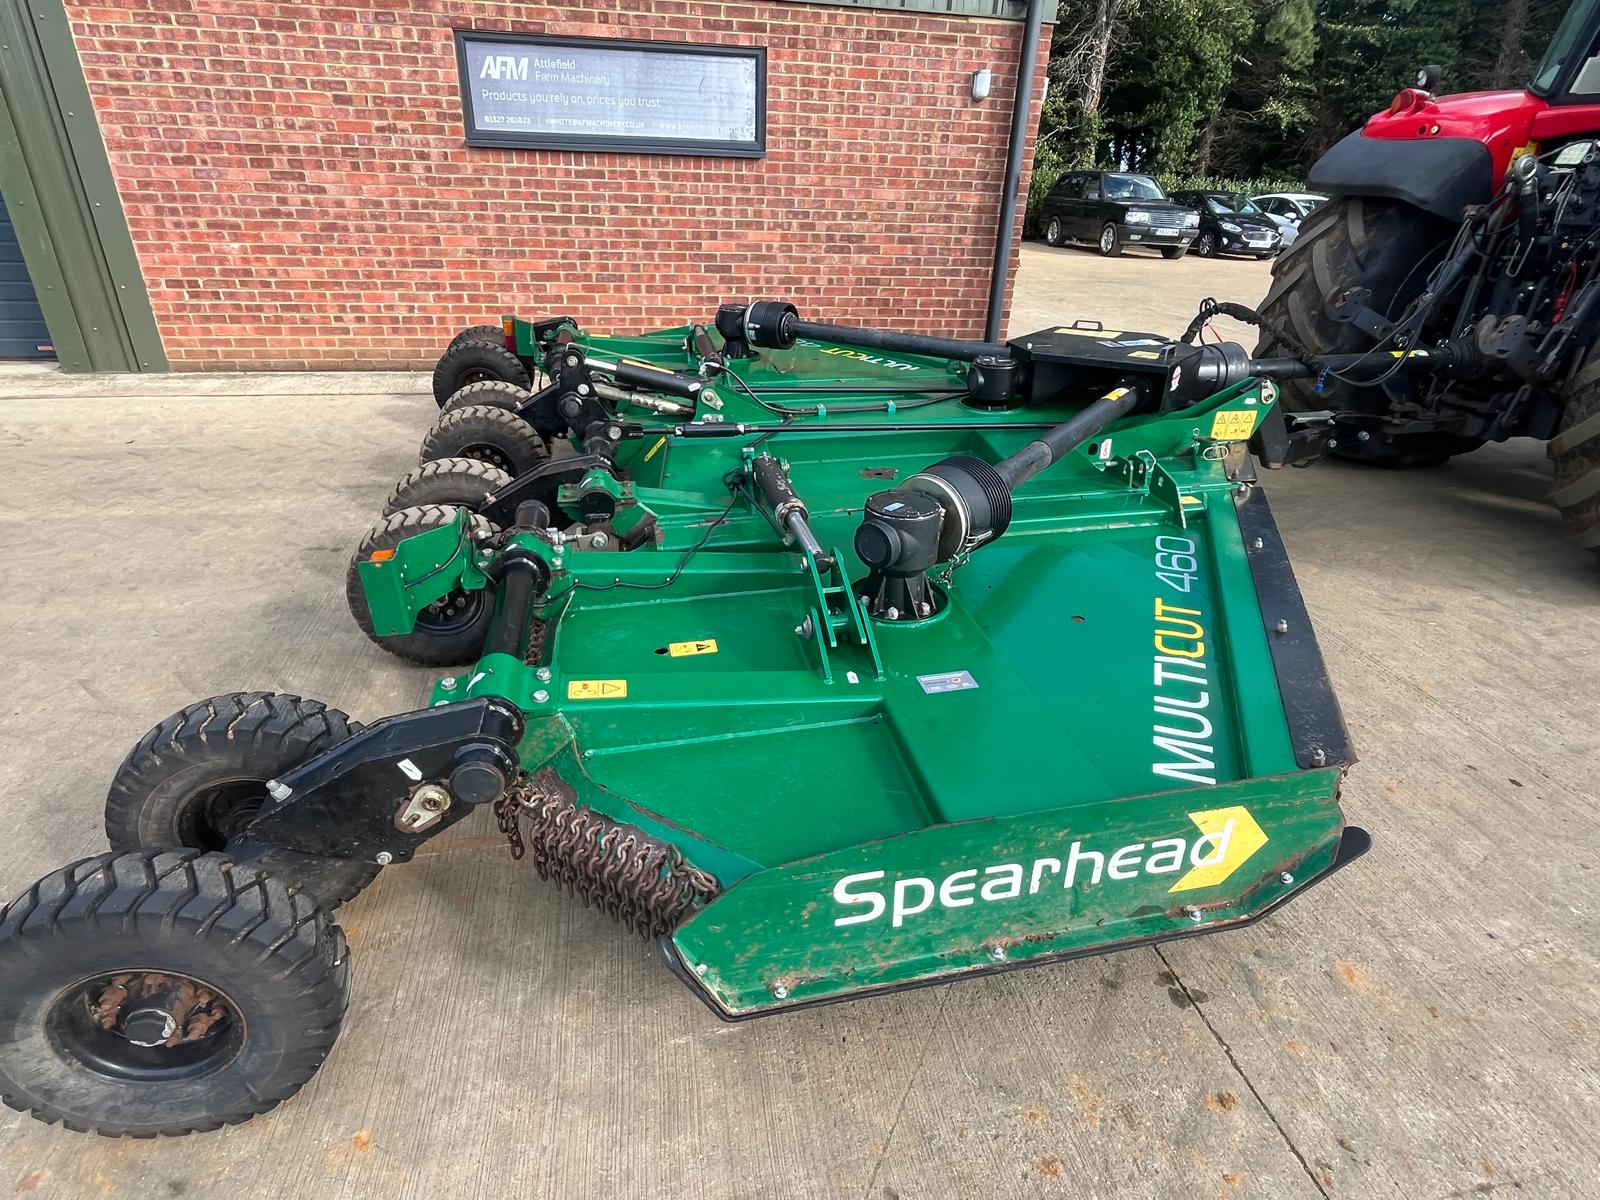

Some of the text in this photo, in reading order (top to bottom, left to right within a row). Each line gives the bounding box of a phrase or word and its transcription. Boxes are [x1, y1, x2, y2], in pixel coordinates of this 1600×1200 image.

[479, 55, 529, 81] AFM
[535, 70, 610, 86] Farm Machinery
[481, 89, 528, 101] Products
[530, 92, 548, 104] you
[550, 92, 569, 105] rely
[586, 95, 616, 107] prices
[618, 97, 637, 109] you
[1152, 535, 1217, 785] MULTICUT 460
[833, 819, 1237, 928] Spearhead
